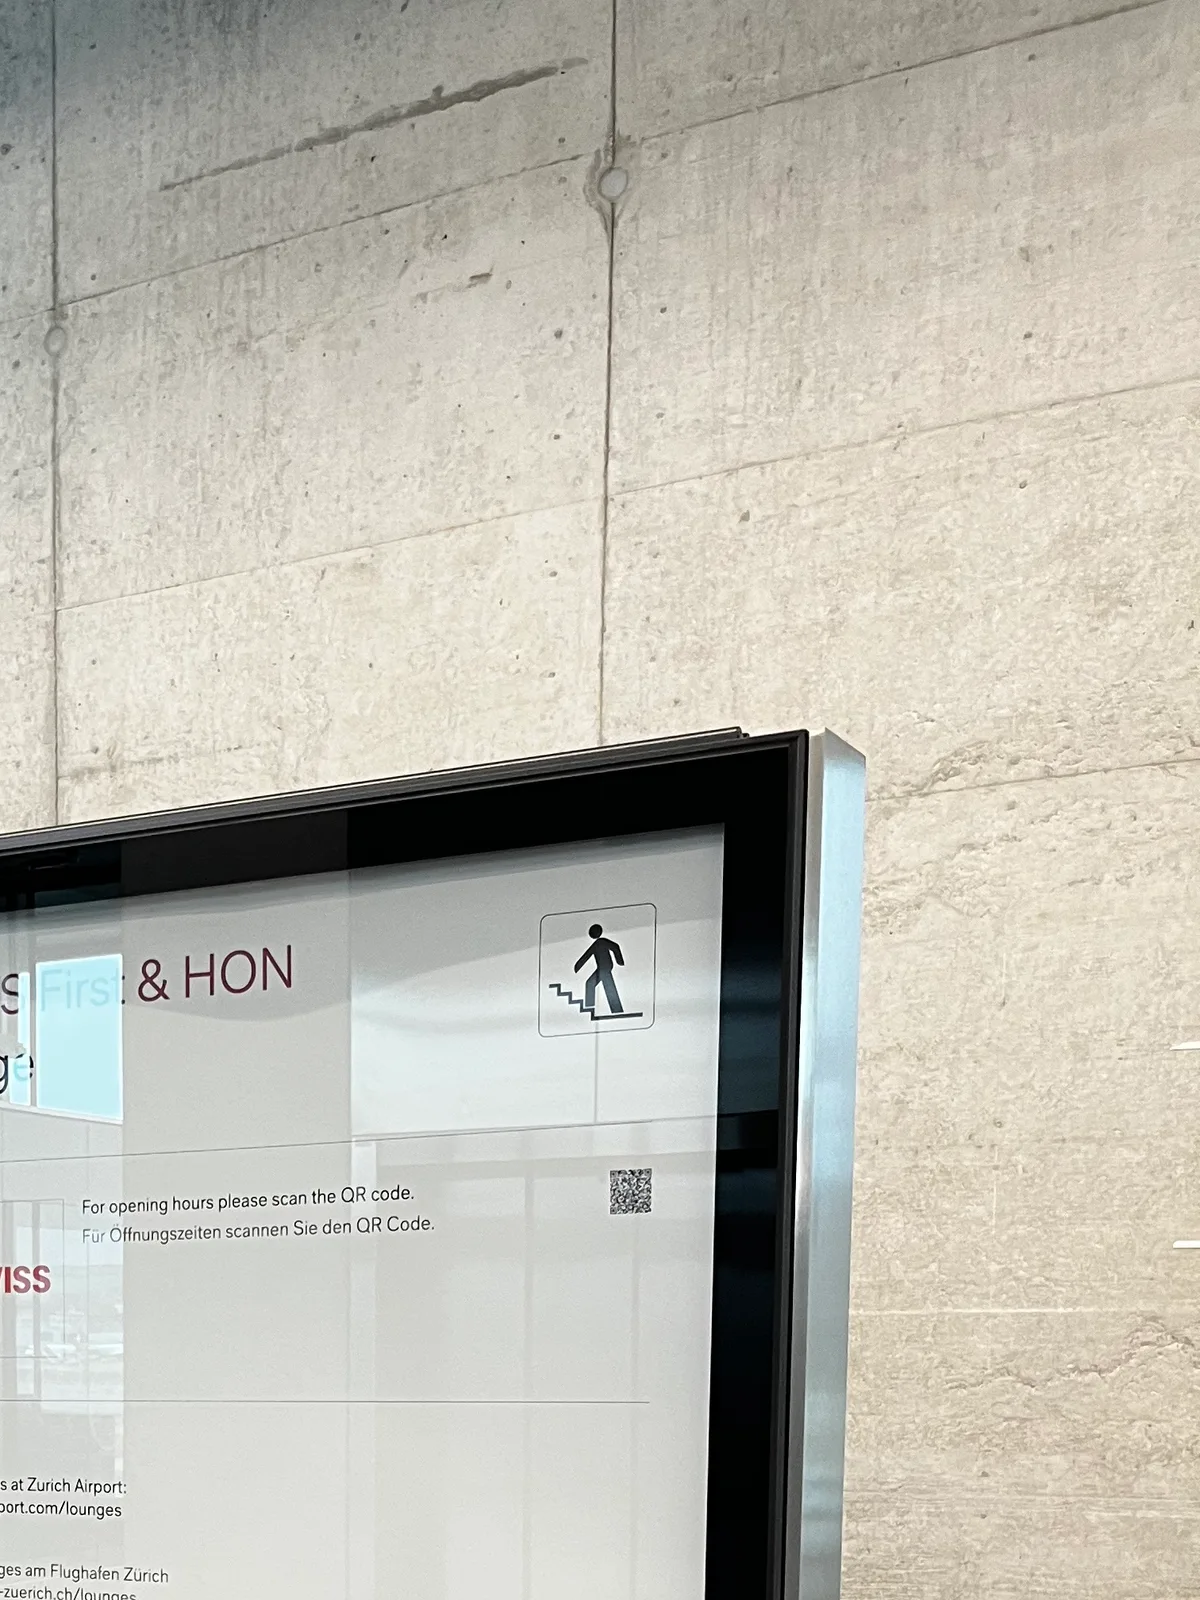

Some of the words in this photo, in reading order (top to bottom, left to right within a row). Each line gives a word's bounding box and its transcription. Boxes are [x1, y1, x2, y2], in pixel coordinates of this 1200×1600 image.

[41, 967, 126, 1012] First
[138, 958, 170, 1003] &
[185, 945, 293, 999] HON
[82, 1199, 105, 1214] For
[109, 1197, 168, 1217] opening
[172, 1195, 214, 1211] hours
[218, 1193, 268, 1212] please
[272, 1193, 307, 1207] scan
[311, 1188, 337, 1205] the
[341, 1186, 367, 1204] QR
[371, 1184, 415, 1201] code.
[82, 1228, 106, 1244] Für
[109, 1223, 221, 1245] Öffnungszeiten
[225, 1223, 289, 1239] scannen
[293, 1219, 318, 1236] Sie
[322, 1219, 352, 1235] den
[356, 1216, 382, 1234] QR
[387, 1215, 435, 1233] Code.
[10, 1478, 24, 1491] at
[27, 1476, 71, 1493] Zurich
[74, 1478, 128, 1497] Airport:
[25, 1565, 47, 1578] am
[50, 1563, 120, 1583] Flughafen
[123, 1566, 169, 1583] Zürich
